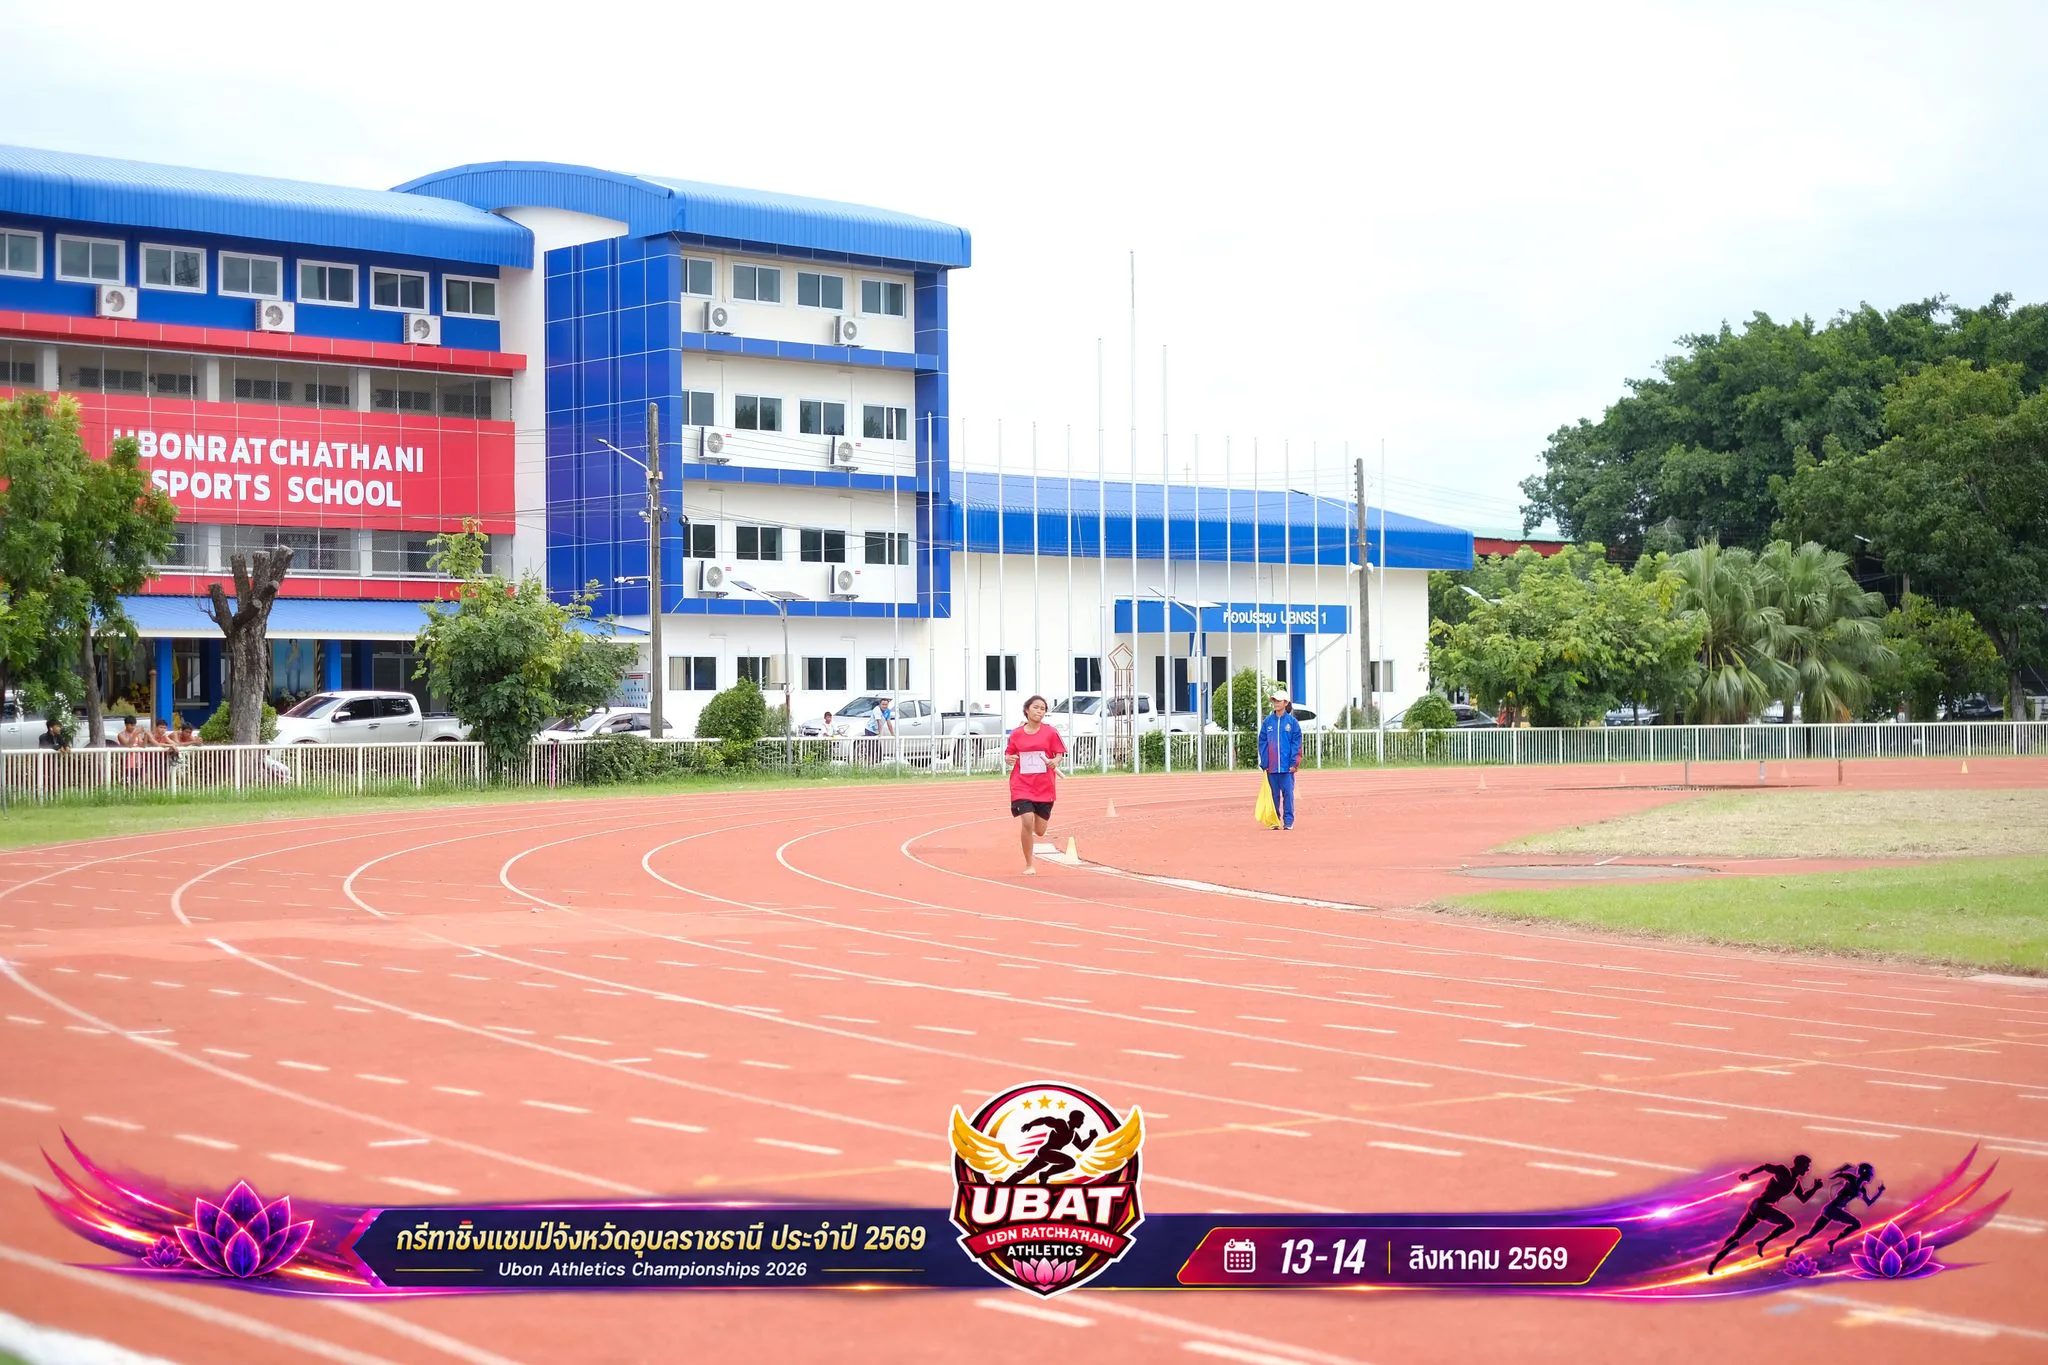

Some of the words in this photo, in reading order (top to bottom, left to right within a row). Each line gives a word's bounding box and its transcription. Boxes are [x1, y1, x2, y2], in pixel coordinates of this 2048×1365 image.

[151, 469, 270, 502] SPORTS
[287, 476, 401, 508] SCHOOL
[1321, 611, 1327, 625] 1
